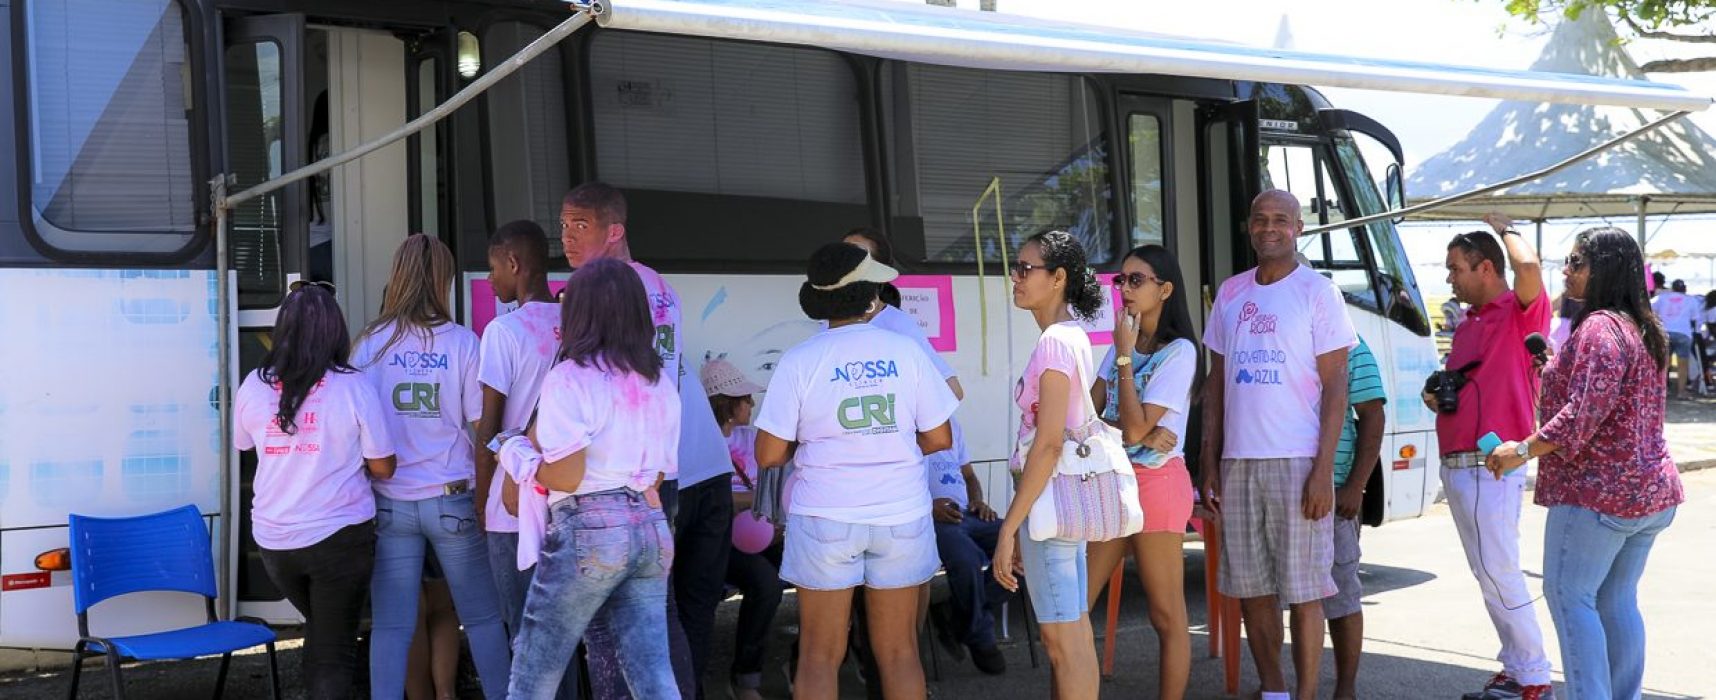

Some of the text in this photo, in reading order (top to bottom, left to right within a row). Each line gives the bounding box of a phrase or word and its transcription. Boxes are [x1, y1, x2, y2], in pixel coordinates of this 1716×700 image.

[1259, 120, 1295, 128] ENIOR
[901, 294, 930, 302] FERIÇÃO
[388, 351, 448, 370] NOSSA
[830, 360, 899, 383] NOSSA
[1254, 368, 1282, 385] AZUL
